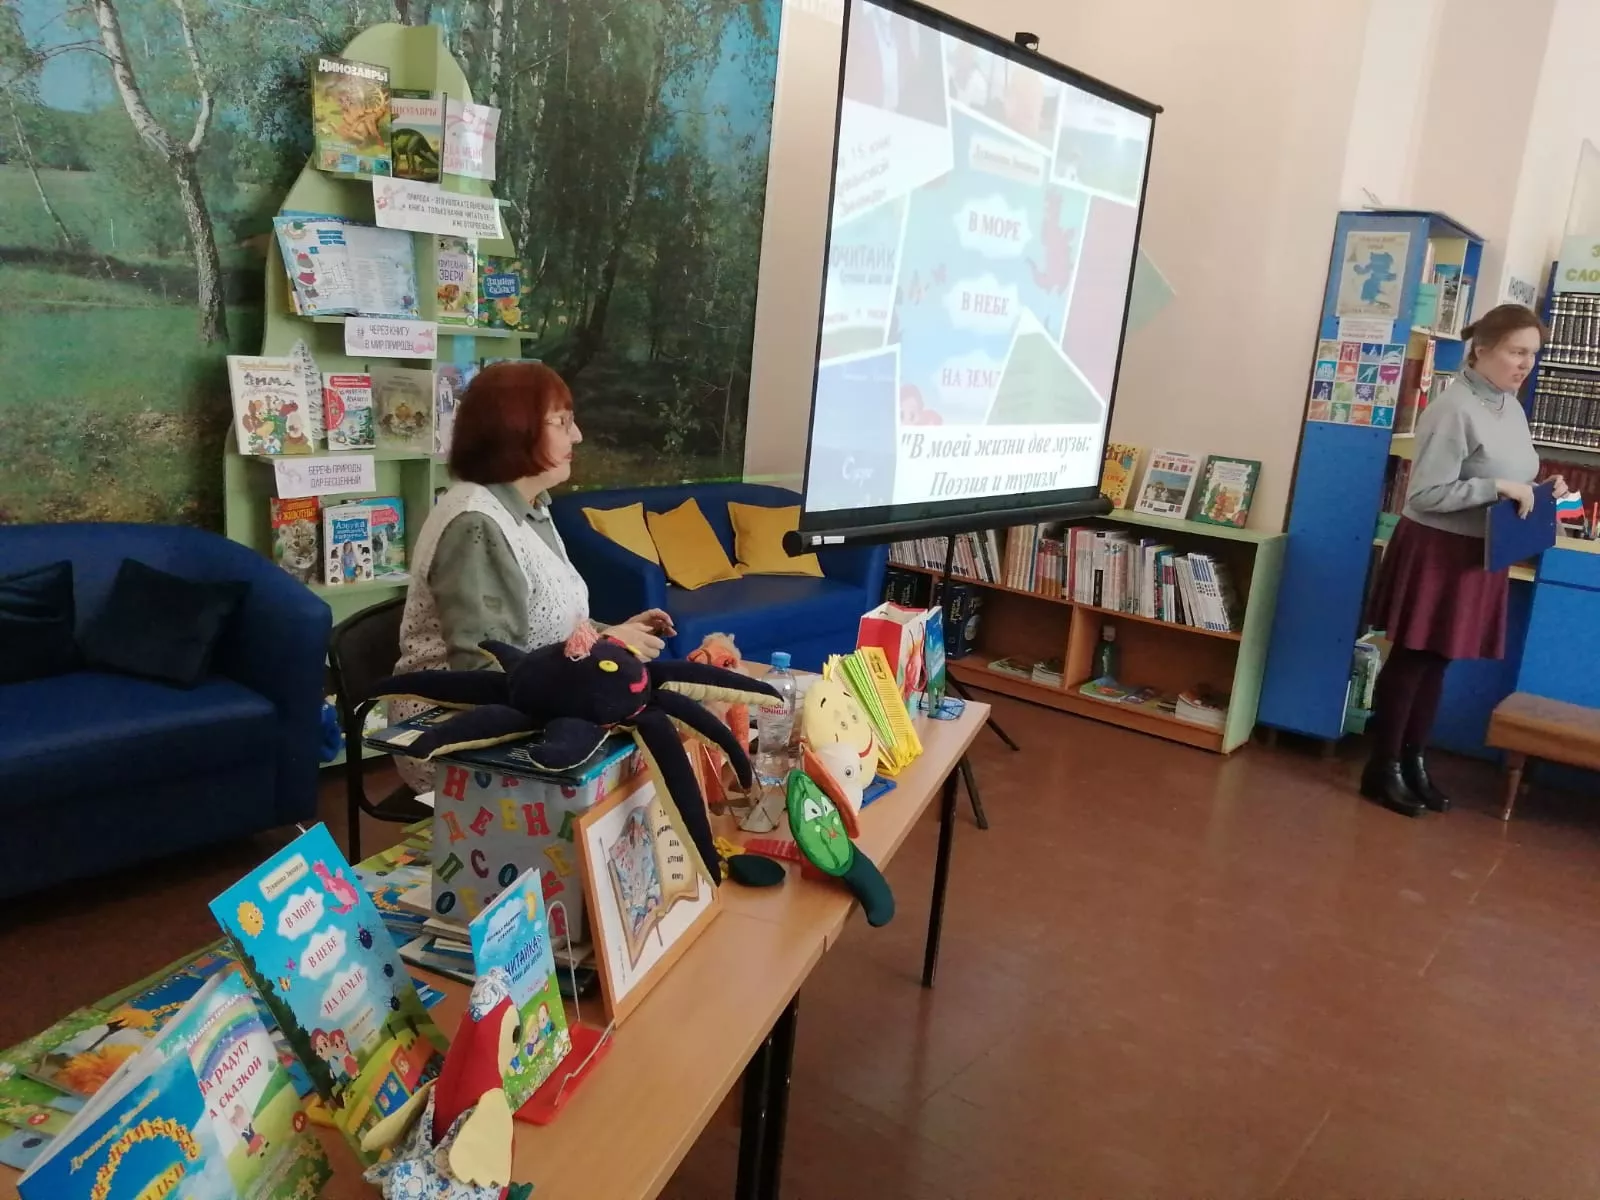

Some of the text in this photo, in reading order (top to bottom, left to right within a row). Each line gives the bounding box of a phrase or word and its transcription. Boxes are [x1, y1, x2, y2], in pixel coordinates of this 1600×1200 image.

[318, 58, 388, 82] ДИНОЗАВРЫ
[968, 211, 1022, 241] В МОРЕ
[439, 269, 464, 282] ЗВЕРИ
[961, 291, 1010, 316] В НЕБЕ
[369, 324, 410, 337] ЧЕРЕЗ КНИГУ
[364, 339, 414, 351] В МИР ПРИРОДЫ
[942, 367, 962, 387] НА
[901, 432, 1092, 459] "В моей жизни две музы:
[308, 463, 361, 475] БЕРЕЧЬ ПРИРОДЫ
[929, 464, 1068, 497] Поэзия и туризм"
[284, 896, 317, 928] В МОРЕ
[308, 935, 337, 968] В НЕБЕ
[324, 998, 340, 1014] НА
[337, 968, 364, 1001] ЗЕМЛЕ
[214, 1040, 250, 1085] РАДУГУ
[218, 1055, 262, 1109] СКАЗКОЙ
